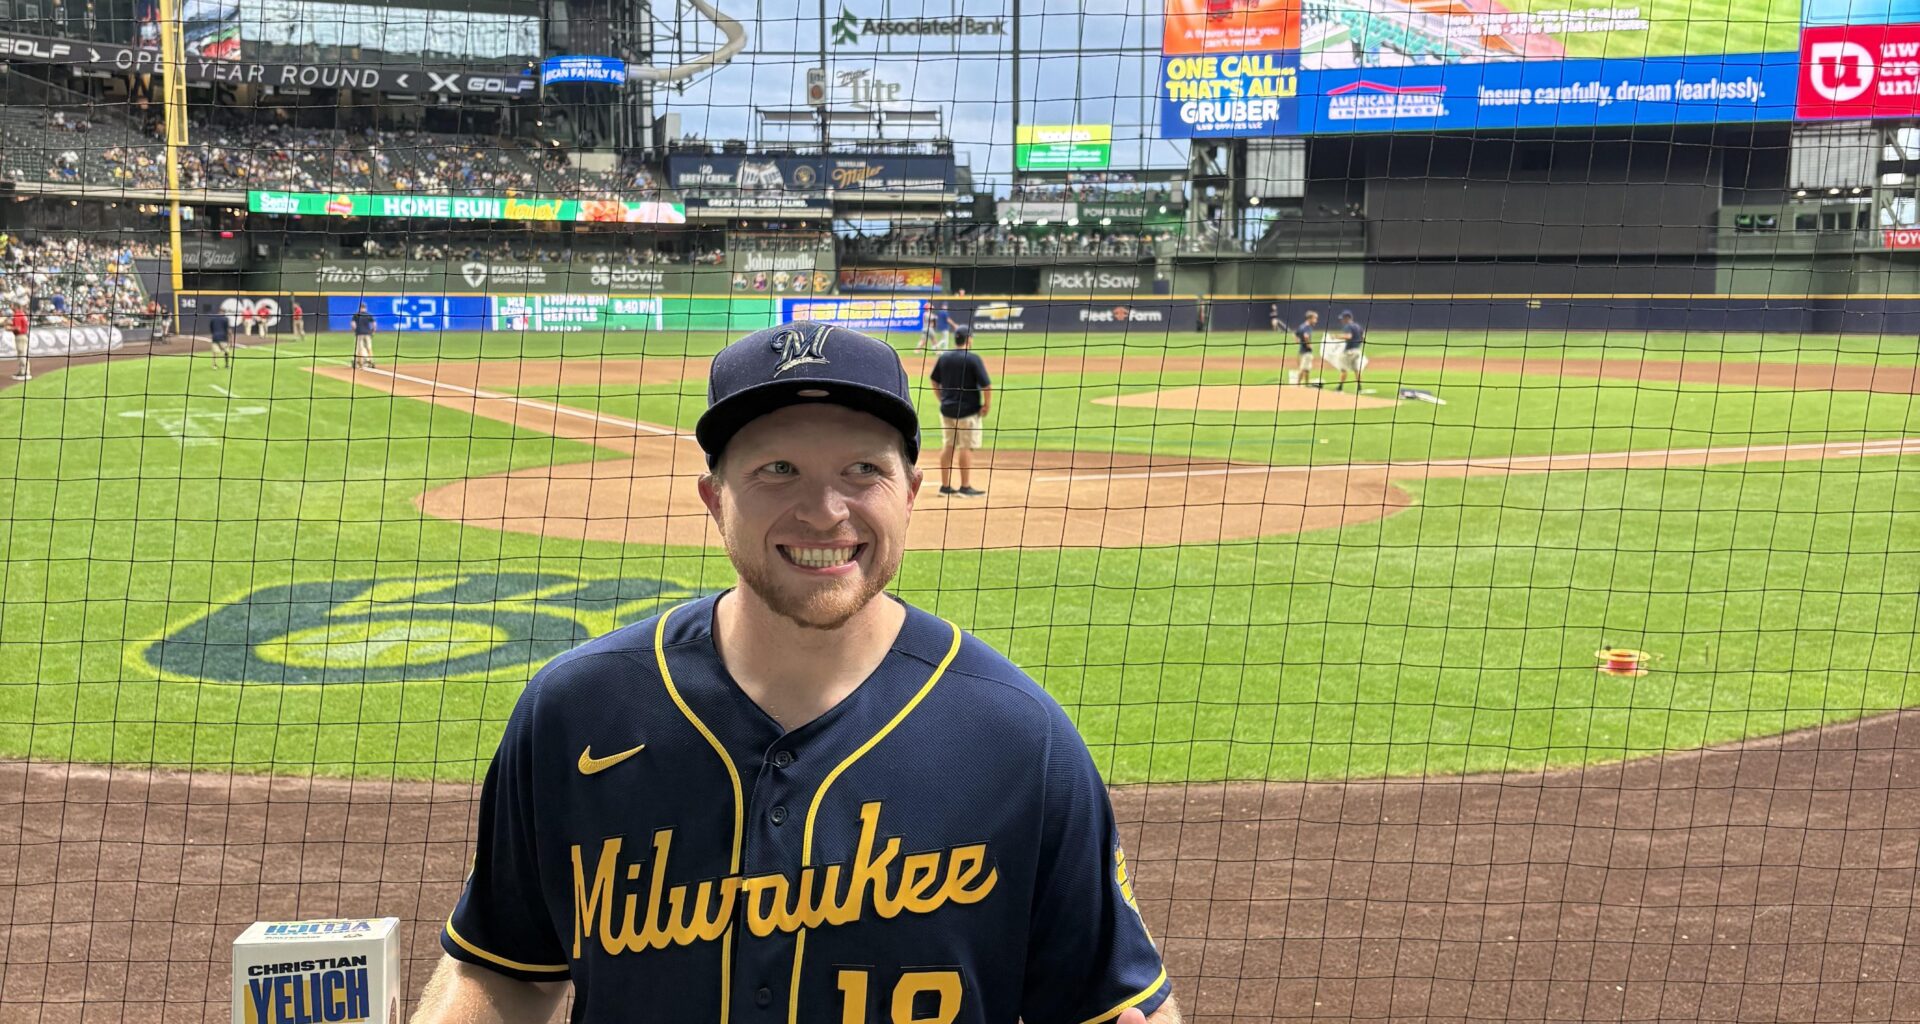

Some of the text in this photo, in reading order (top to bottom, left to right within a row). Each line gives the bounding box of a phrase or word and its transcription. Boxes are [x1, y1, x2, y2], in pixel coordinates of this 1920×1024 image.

[862, 17, 1008, 36] Associated Bank
[0, 37, 70, 59] GOLF
[1879, 42, 1920, 58] uw
[198, 60, 265, 84] YEAR
[281, 65, 380, 89] ROUND
[570, 68, 610, 79] FAMILY
[1167, 57, 1218, 80] ONE
[427, 71, 536, 94] X GOLF
[853, 79, 901, 101] Lite
[1165, 76, 1297, 102] THAT'S ALL!
[1479, 76, 1766, 107] Insure carefully, dream fearlessly.
[1330, 93, 1445, 107] AMERICAN FAMILY
[1180, 99, 1280, 124] GRUBER
[1338, 106, 1435, 116] INSURANCE
[832, 165, 884, 189] Miller
[383, 197, 450, 217] HOME
[454, 198, 500, 218] RUN
[708, 199, 733, 207] GREAT
[759, 199, 776, 207] LESS
[1083, 207, 1149, 217] POWER ALLEY
[1889, 231, 1920, 245] TOY
[744, 251, 815, 271] Johnsonville
[316, 265, 363, 283] Tito's
[491, 266, 546, 277] FANDUEL
[611, 264, 664, 283] clover
[1049, 272, 1084, 289] Pick
[1099, 273, 1140, 289] Save
[392, 299, 449, 330] 5:21
[542, 307, 598, 322] SEATTLE
[1079, 309, 1162, 323] Fleet Farm
[974, 322, 1024, 331] CHEVROLET
[571, 801, 998, 960] Milwaukee
[248, 954, 367, 977] CHRISTIAN
[249, 967, 370, 1024] YELICH
